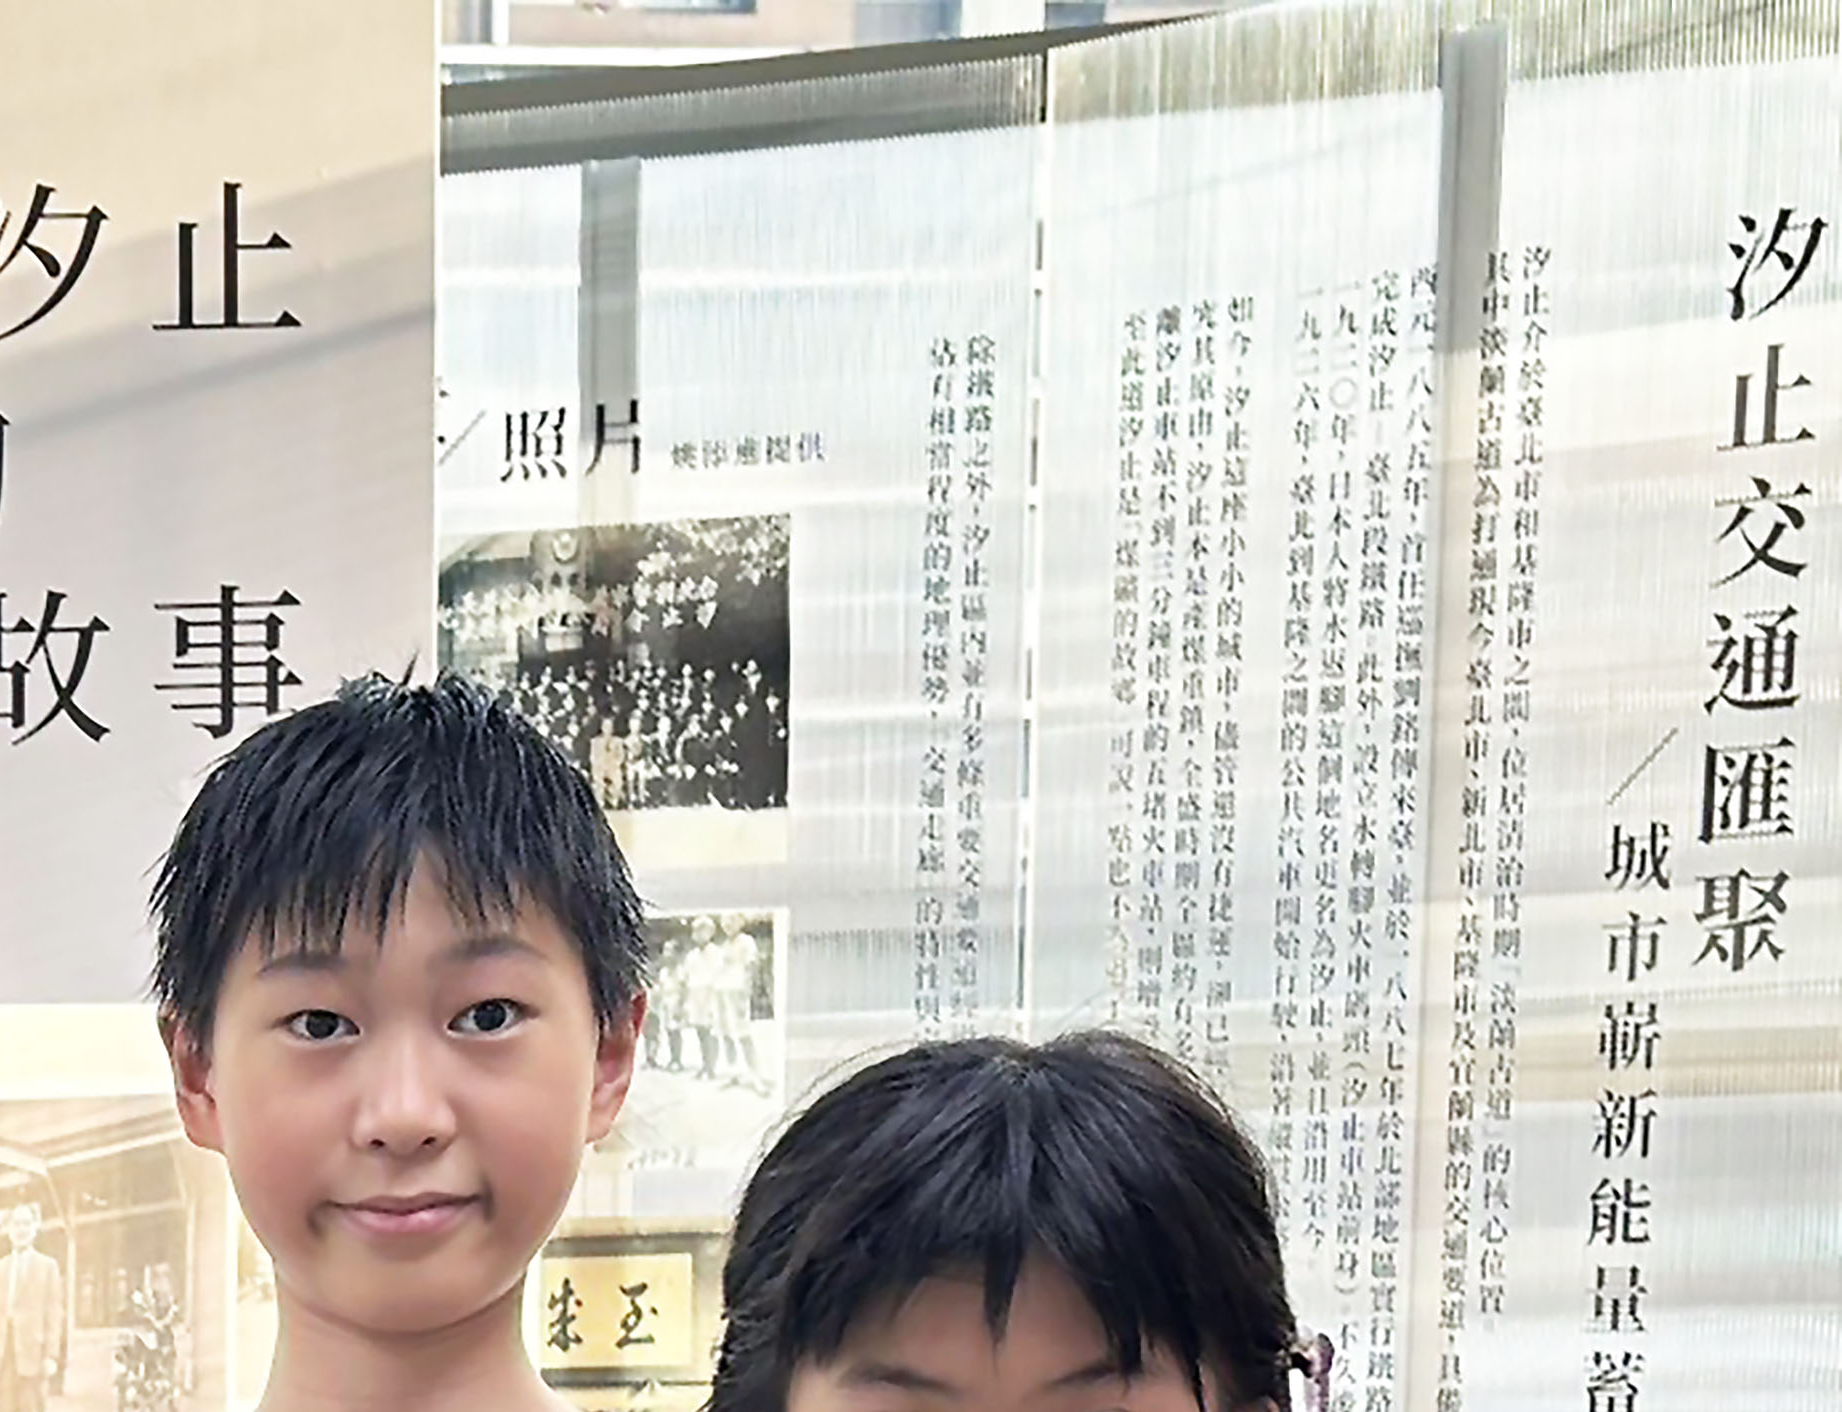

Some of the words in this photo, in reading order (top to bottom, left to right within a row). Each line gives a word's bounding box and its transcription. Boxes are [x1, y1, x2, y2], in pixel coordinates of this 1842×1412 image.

[500, 398, 641, 482] 照片
[1692, 206, 1830, 974] 汐止交通匯聚
